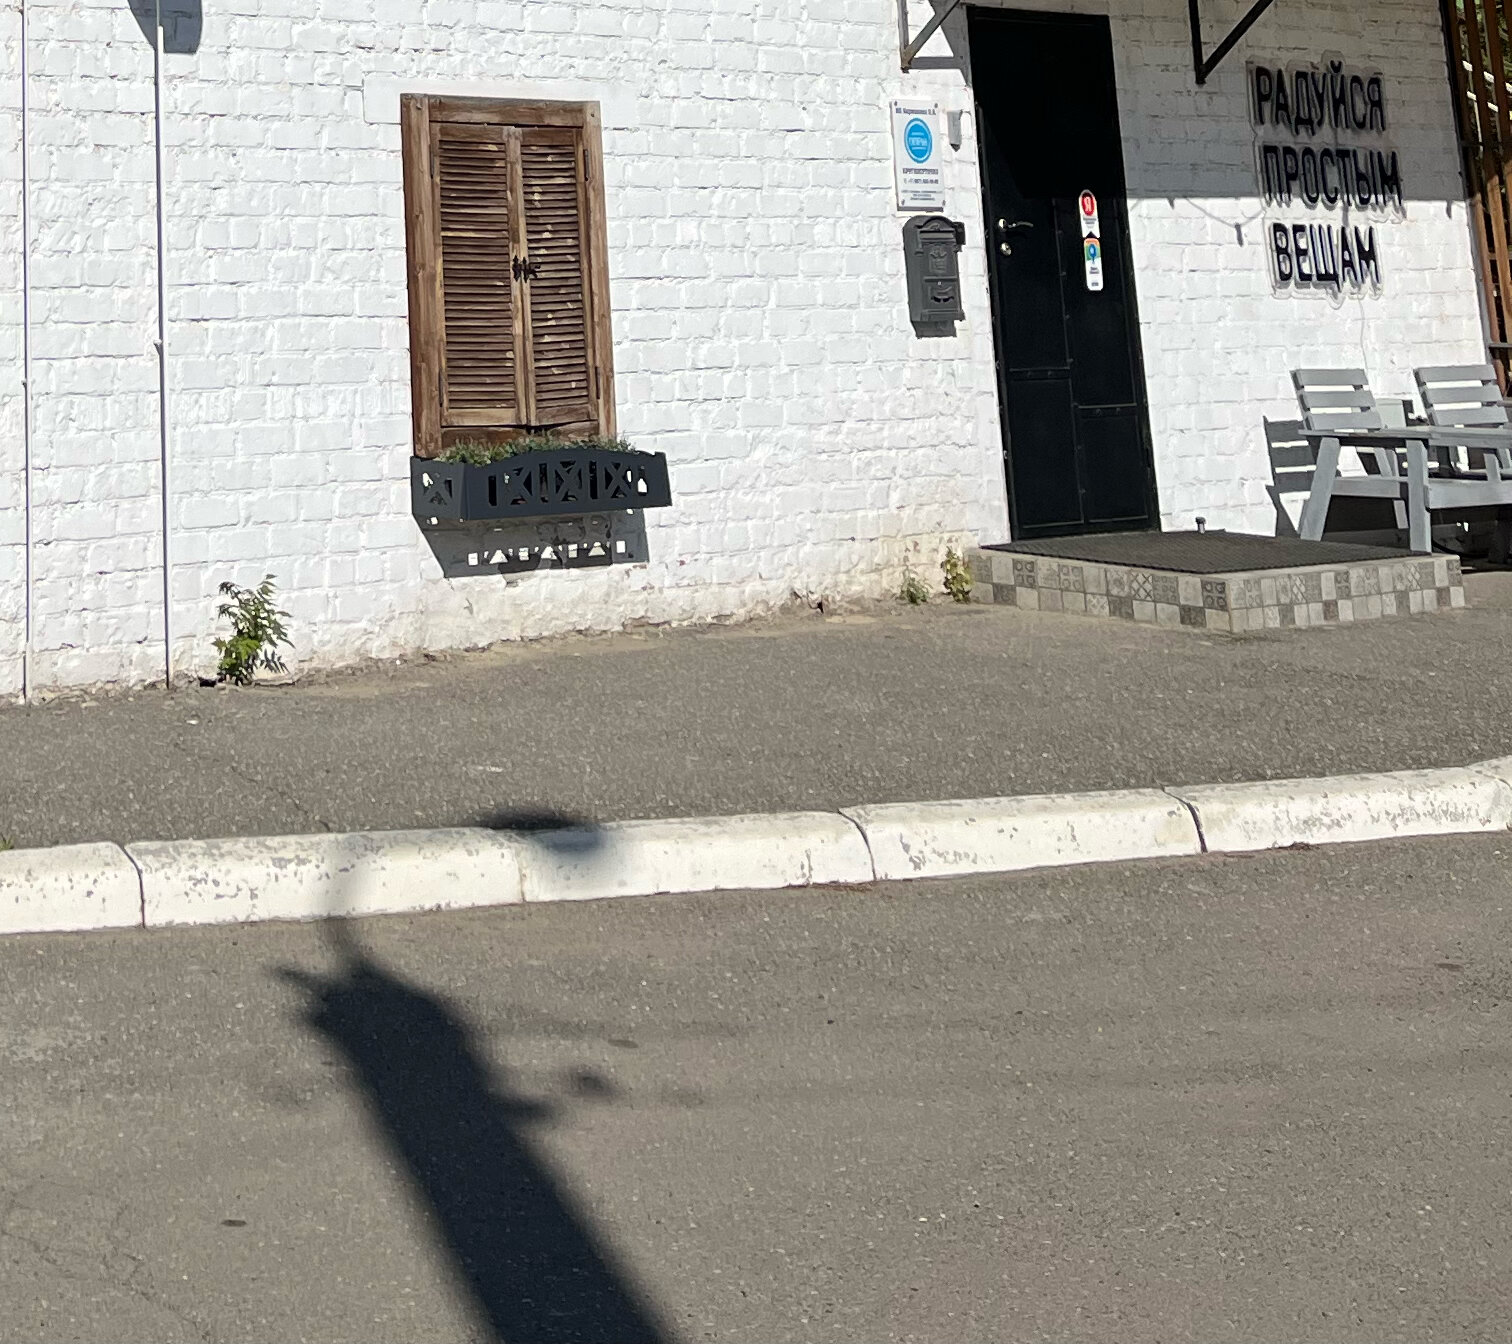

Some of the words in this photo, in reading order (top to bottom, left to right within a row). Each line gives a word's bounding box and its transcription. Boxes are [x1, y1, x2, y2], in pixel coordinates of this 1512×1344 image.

[1256, 60, 1386, 136] РАДУЙСЯ
[1262, 145, 1404, 207] ПРОСТЫМ
[1273, 222, 1382, 293] ВЕЩАМ
